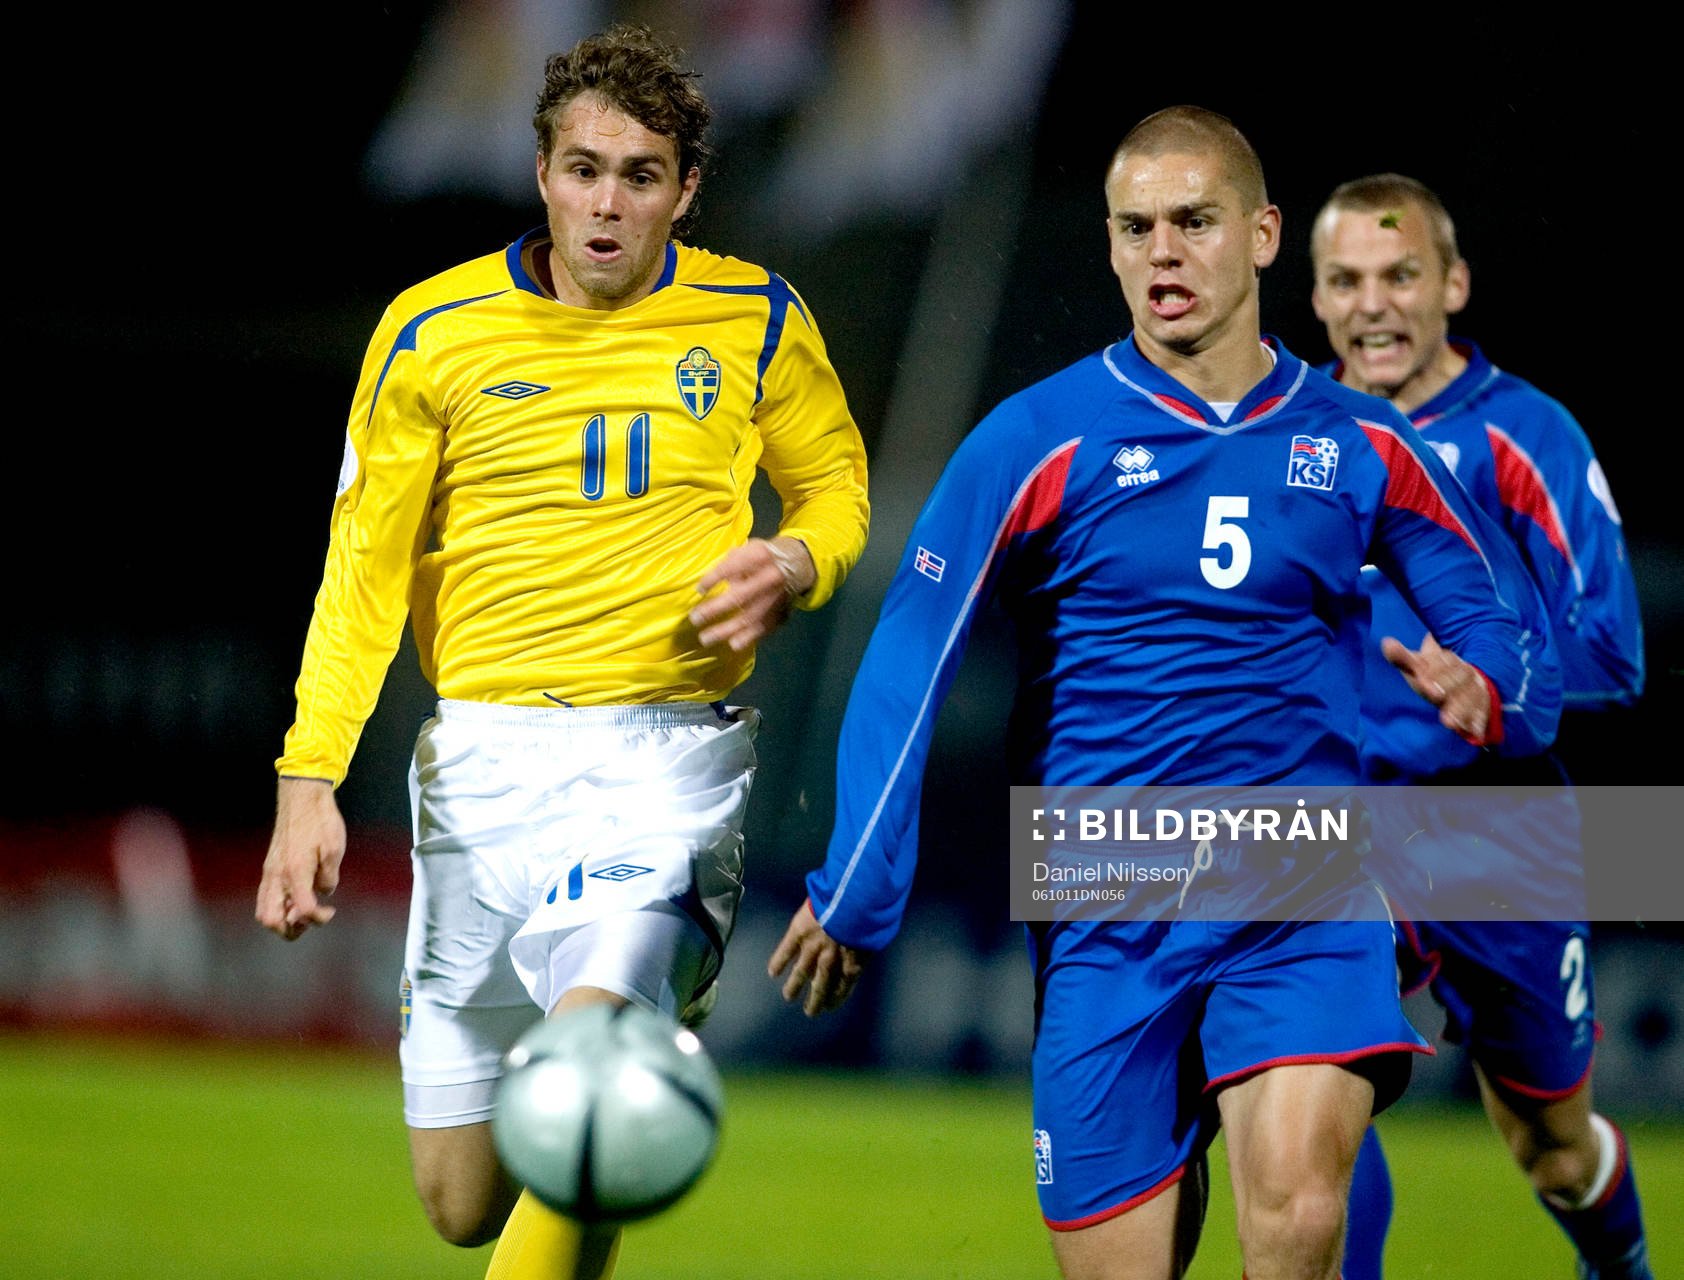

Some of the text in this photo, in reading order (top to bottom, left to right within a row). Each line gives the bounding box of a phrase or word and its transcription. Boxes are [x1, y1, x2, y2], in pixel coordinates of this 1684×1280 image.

[581, 412, 650, 501] 11
[1116, 469, 1160, 488] errea
[1199, 495, 1252, 590] 5
[1560, 937, 1588, 1021] 2
